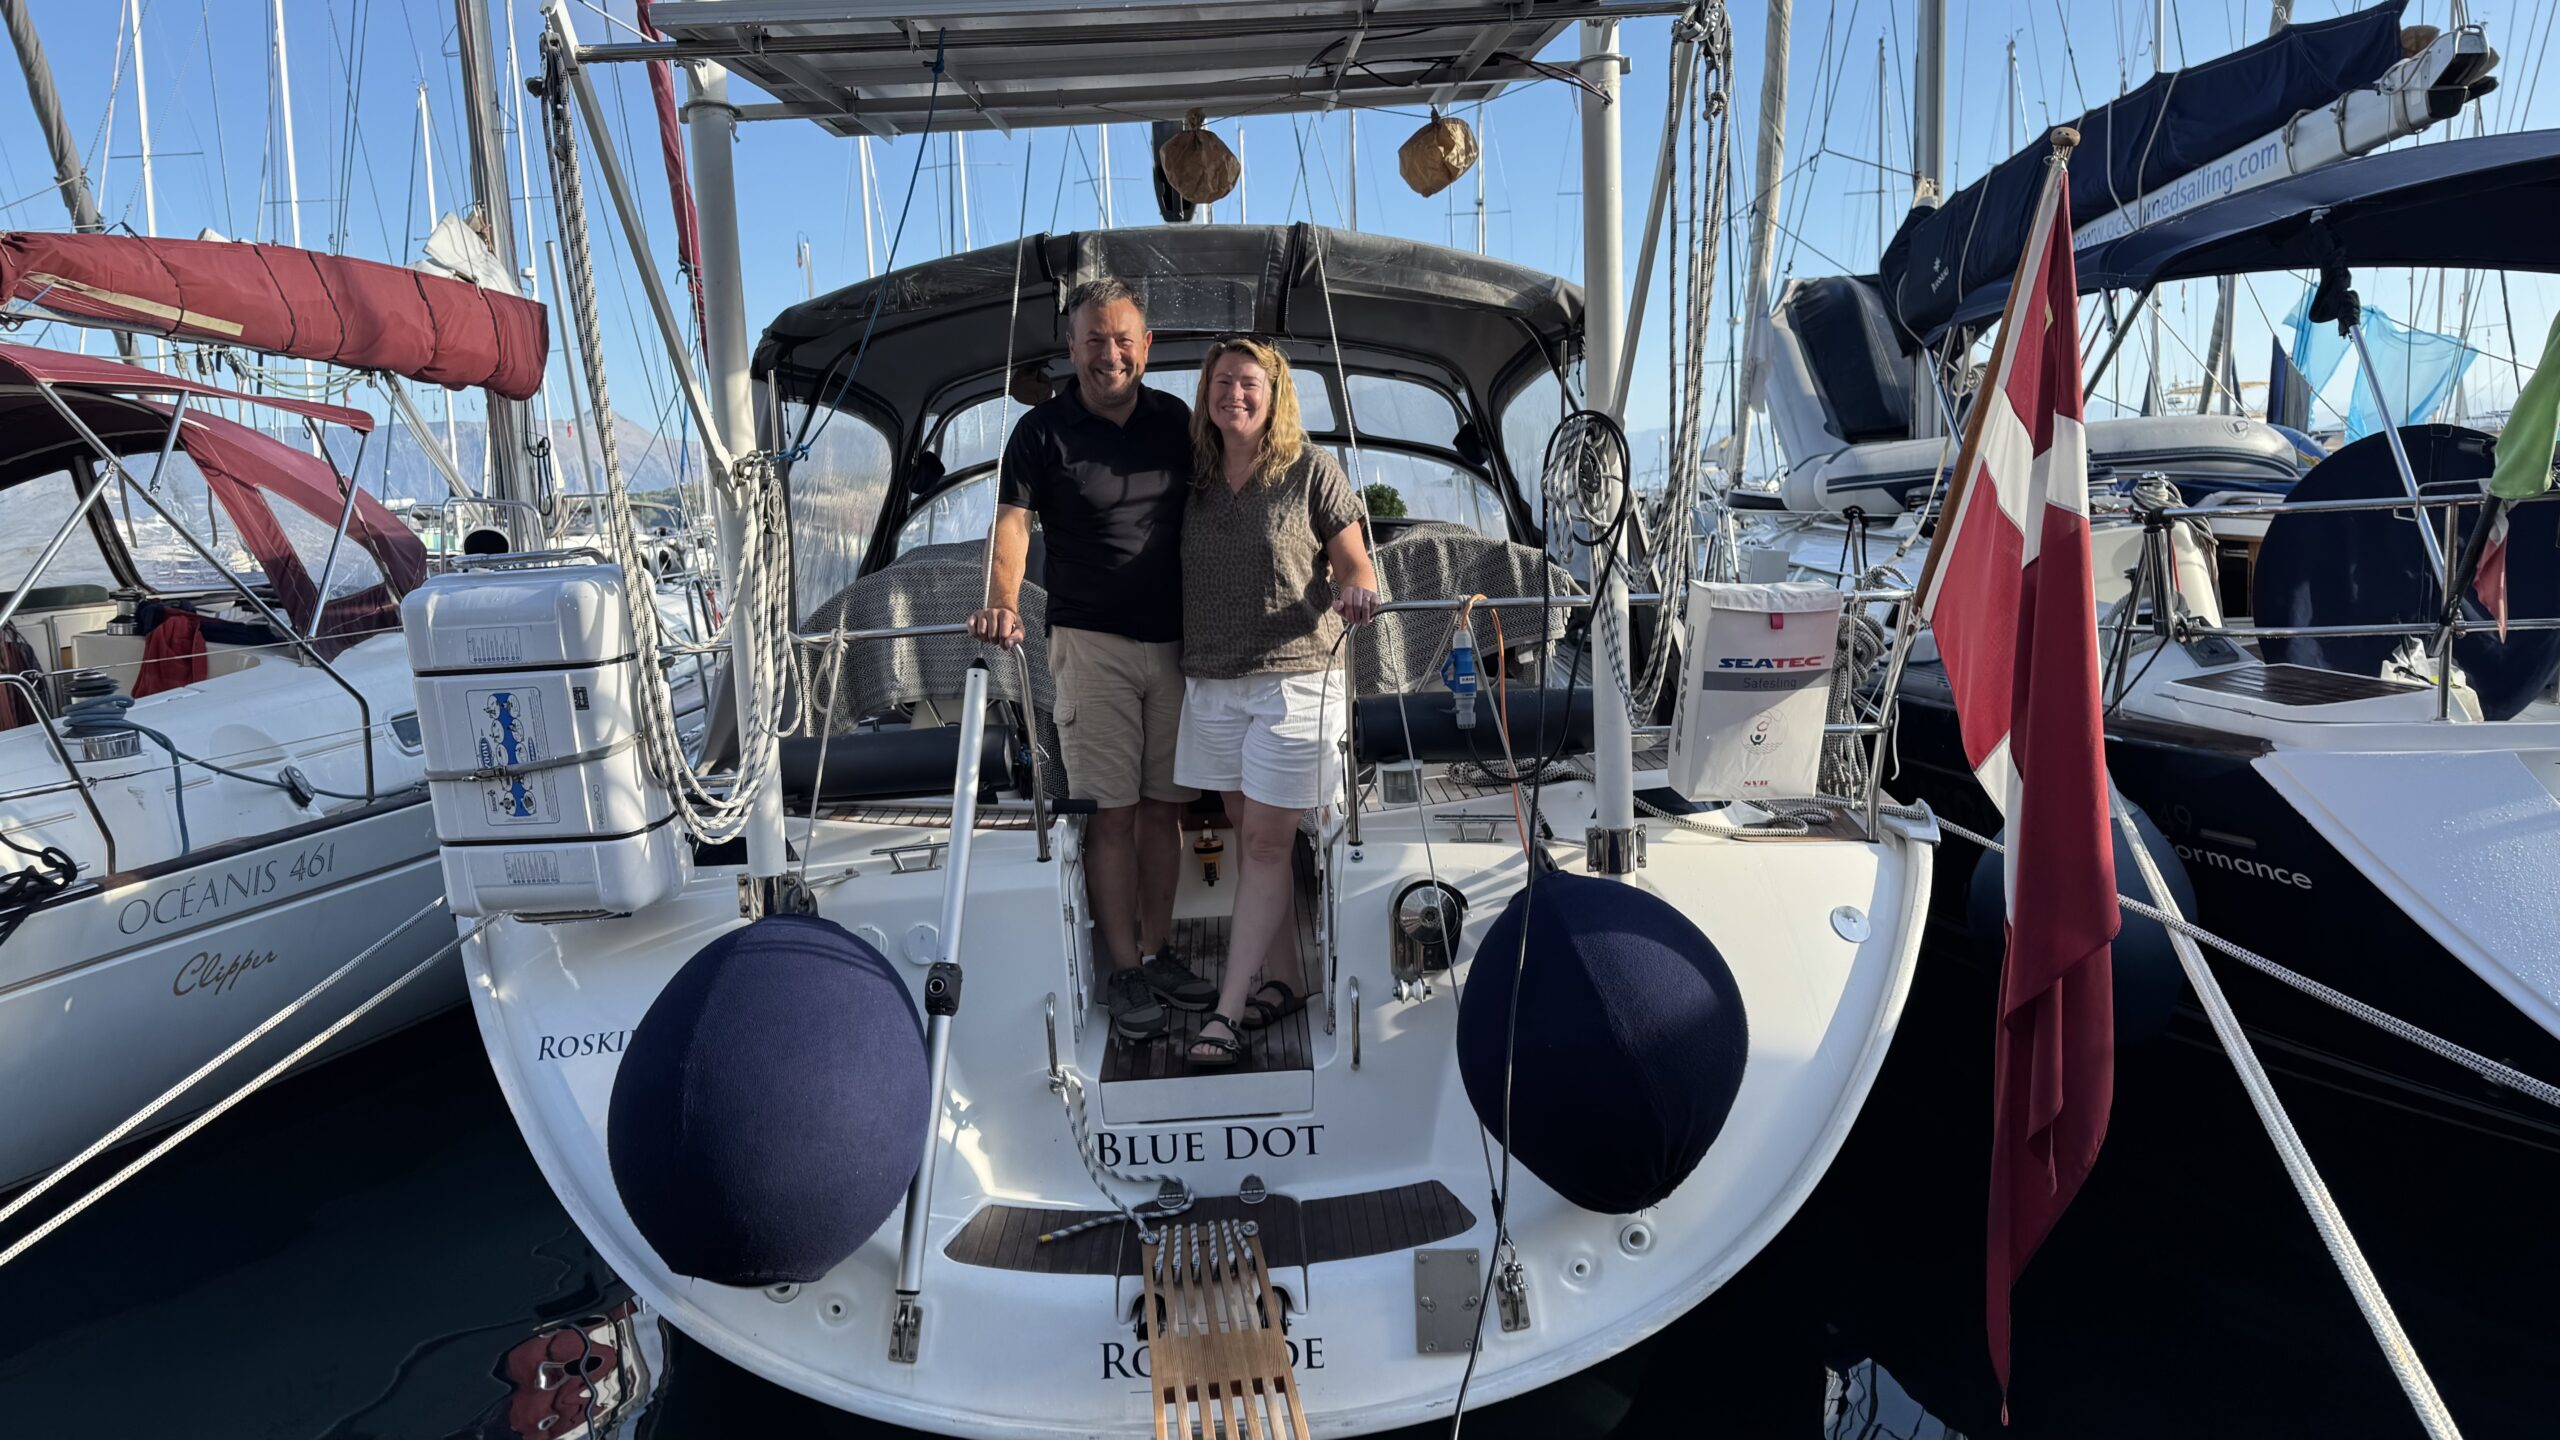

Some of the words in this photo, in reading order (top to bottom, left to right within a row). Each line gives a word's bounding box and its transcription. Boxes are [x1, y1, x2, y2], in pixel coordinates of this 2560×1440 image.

[1718, 656, 1823, 669] SEATEC
[1743, 676, 1797, 690] Safesling
[118, 860, 278, 935] OCÉANIS
[289, 841, 335, 882] 461
[173, 950, 278, 997] Clipper
[537, 1029, 636, 1061] ROSKI
[1095, 1131, 1205, 1167] BLUE
[1222, 1124, 1325, 1160] DOT
